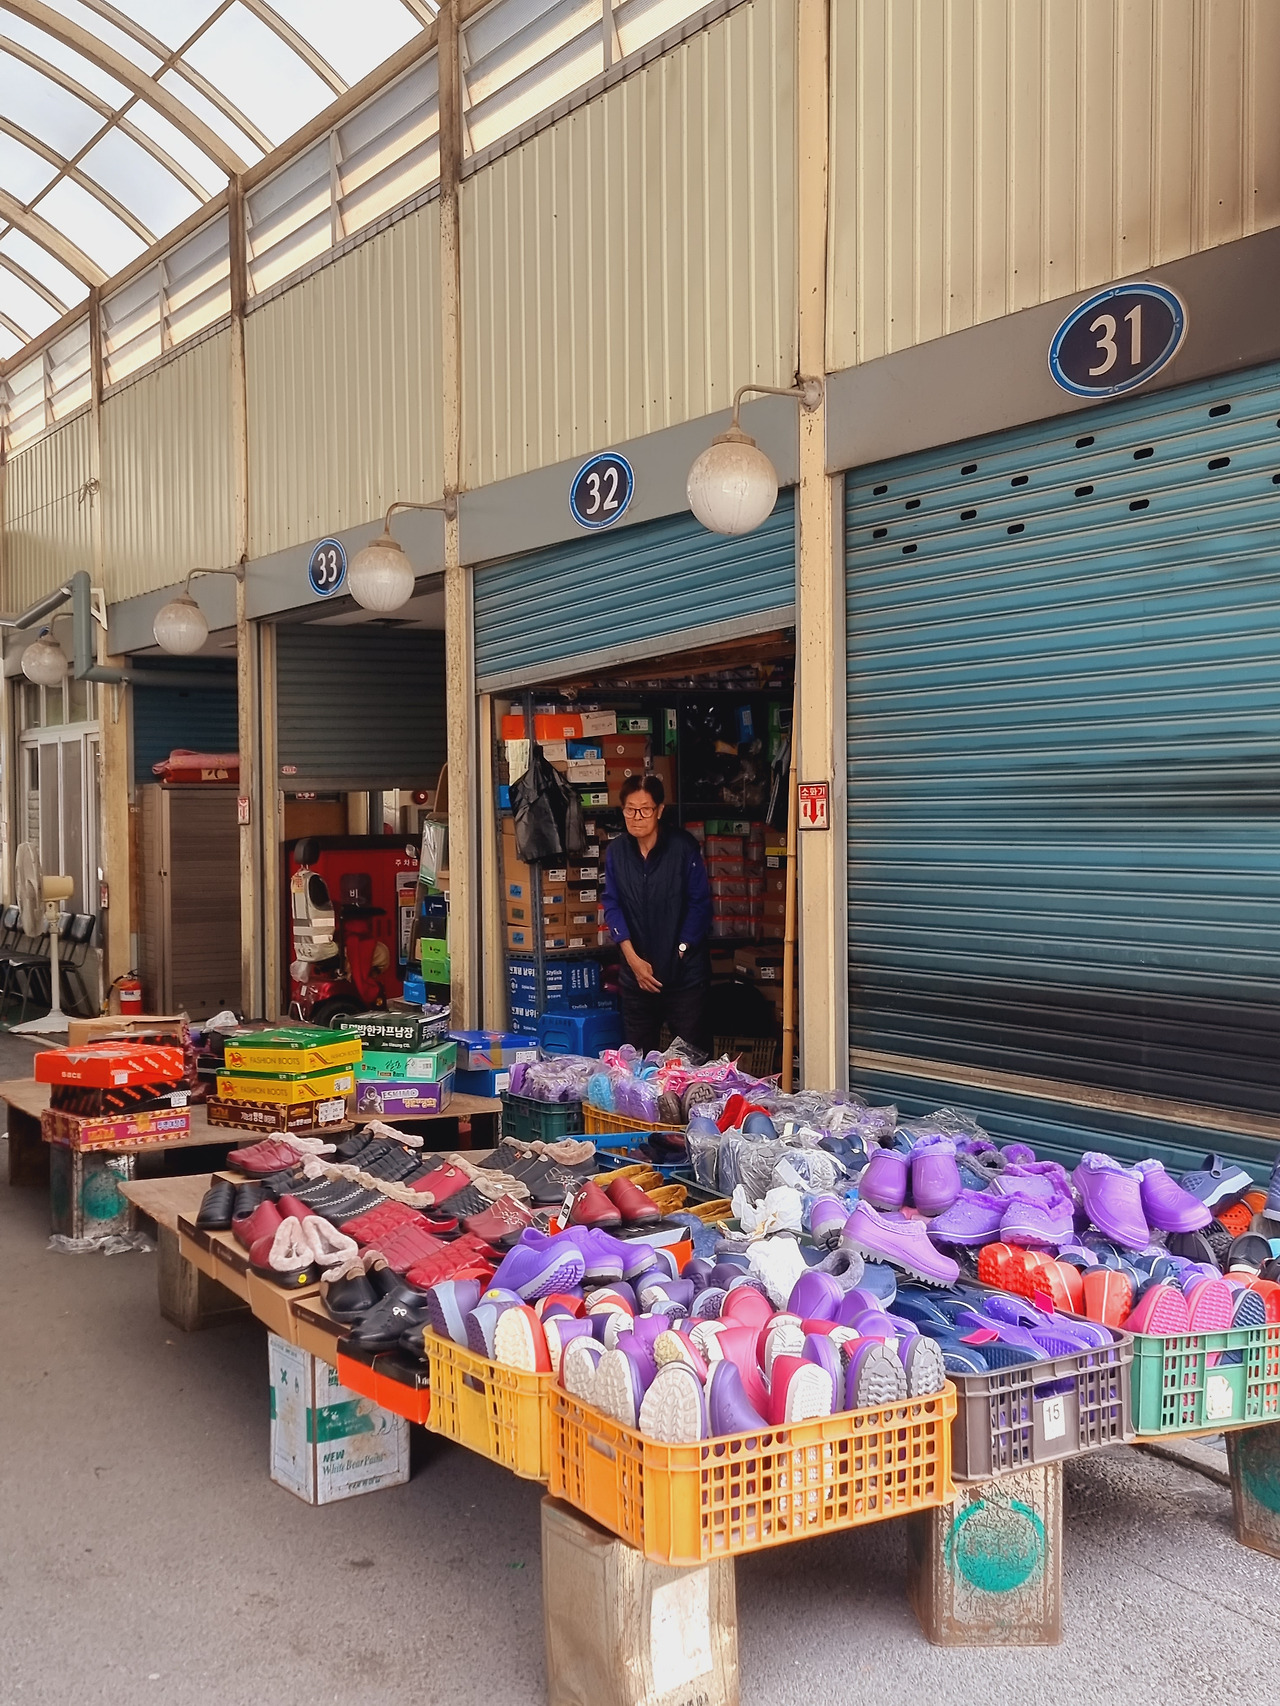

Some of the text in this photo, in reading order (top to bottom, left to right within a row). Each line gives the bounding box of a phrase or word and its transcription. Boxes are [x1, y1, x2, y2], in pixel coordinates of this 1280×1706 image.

[1088, 304, 1142, 376] 31
[585, 466, 619, 515] 32
[317, 550, 337, 585] 33
[801, 787, 825, 796] 소화기
[278, 1057, 300, 1065] BOOTS
[240, 1085, 288, 1096] FASHION BOOTS
[382, 1089, 418, 1099] ESKIMO
[1046, 1403, 1060, 1422] 15
[323, 1449, 345, 1463] NEW
